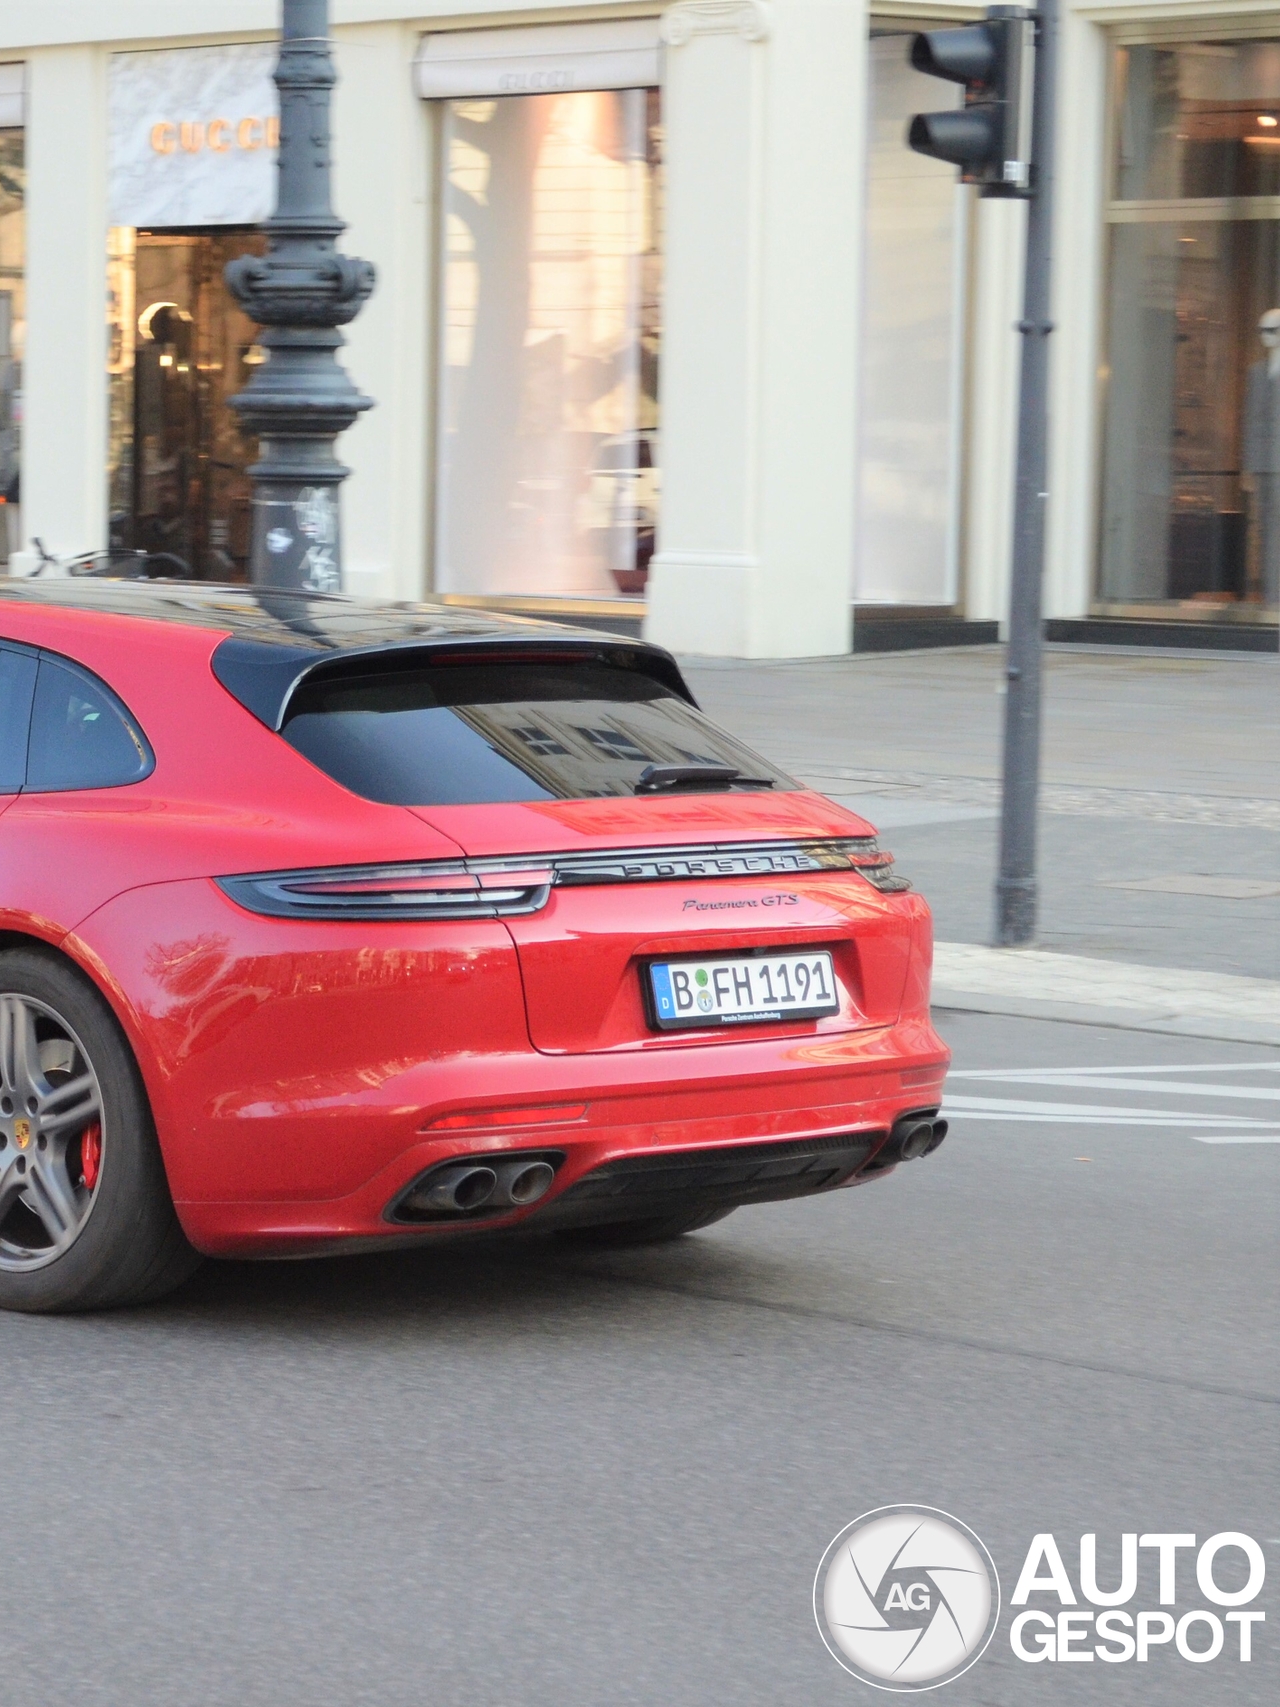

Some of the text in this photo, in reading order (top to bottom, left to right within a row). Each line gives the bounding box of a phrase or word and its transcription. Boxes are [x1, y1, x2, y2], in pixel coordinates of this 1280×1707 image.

[622, 854, 811, 877] PORSCHE
[681, 894, 799, 912] Panamera GTS
[672, 961, 831, 1010] B FH 1191
[661, 997, 670, 1010] D
